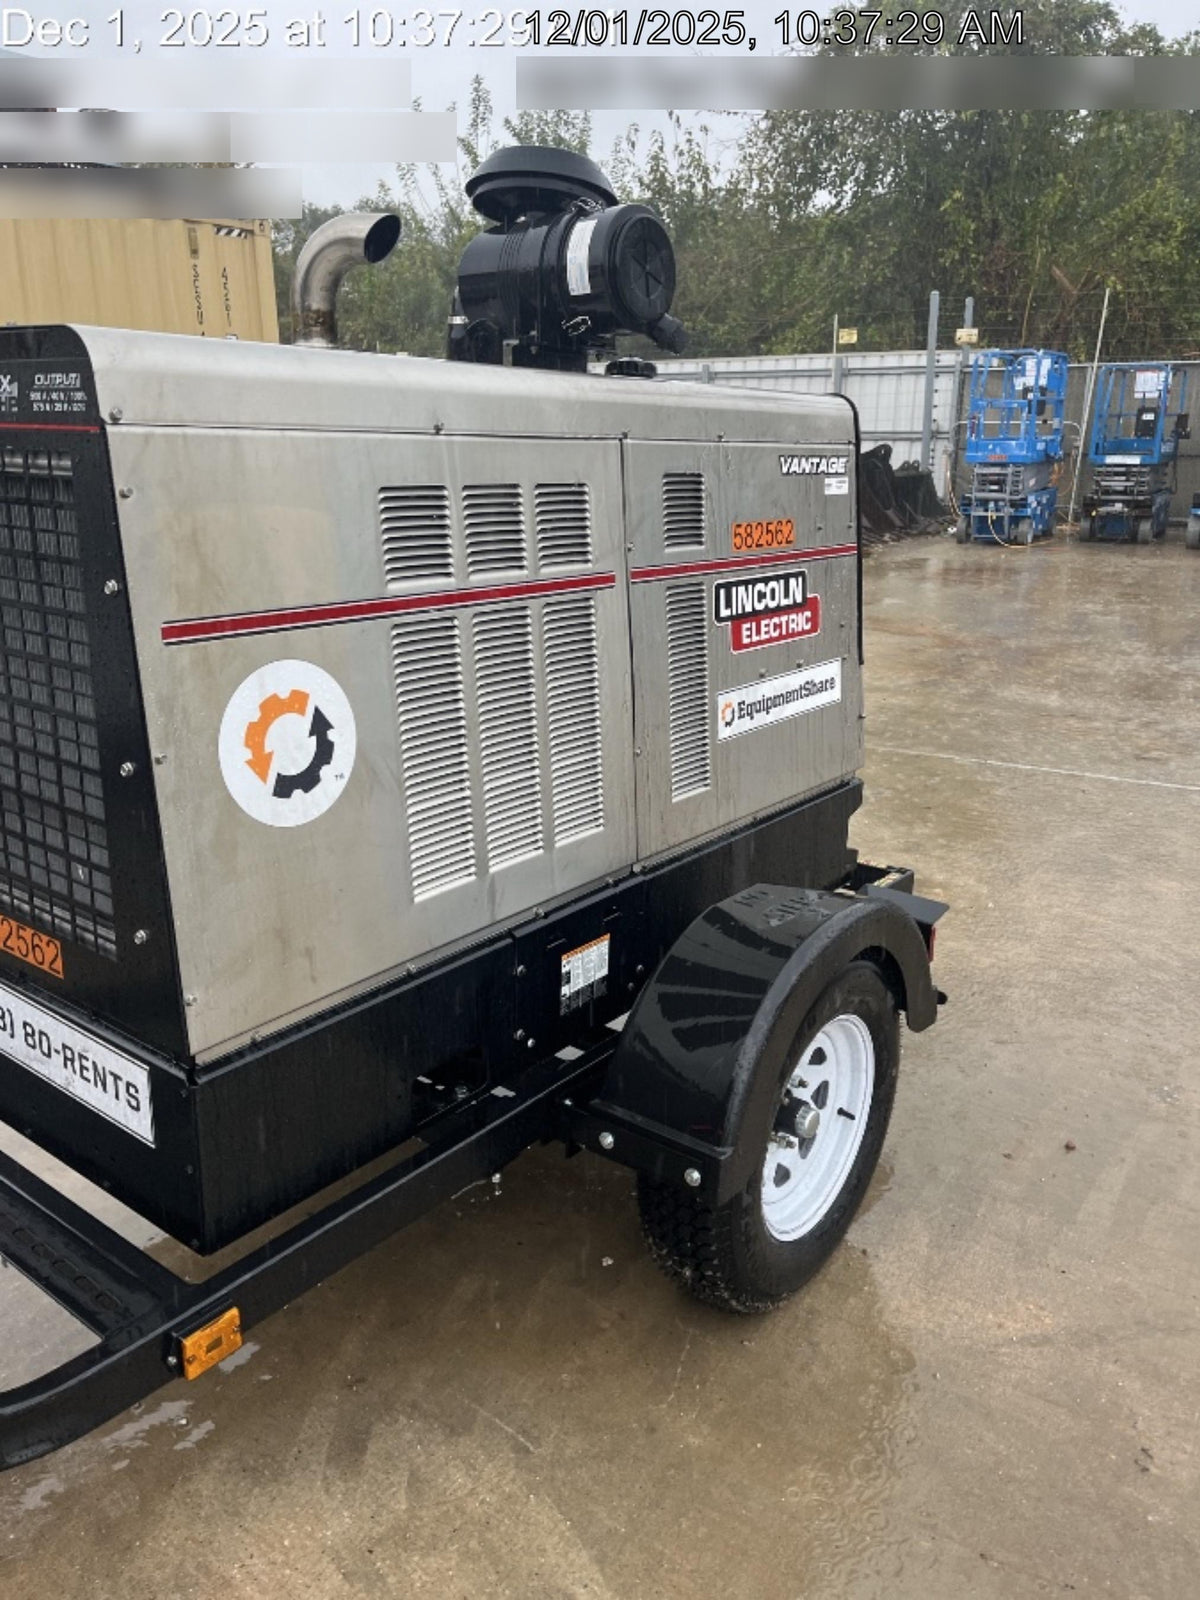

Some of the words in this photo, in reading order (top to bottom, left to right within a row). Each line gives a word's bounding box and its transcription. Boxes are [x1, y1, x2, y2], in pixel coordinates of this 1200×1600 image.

[34, 373, 78, 386] OUTPUT
[779, 455, 849, 476] VANTAGE
[733, 519, 794, 550] 582562
[719, 576, 803, 618] LINCOLN
[741, 611, 812, 645] ELECTRIC
[737, 676, 836, 721] EquipmentShare
[0, 918, 61, 975] 2562
[22, 1020, 141, 1112] 80-RENTS
